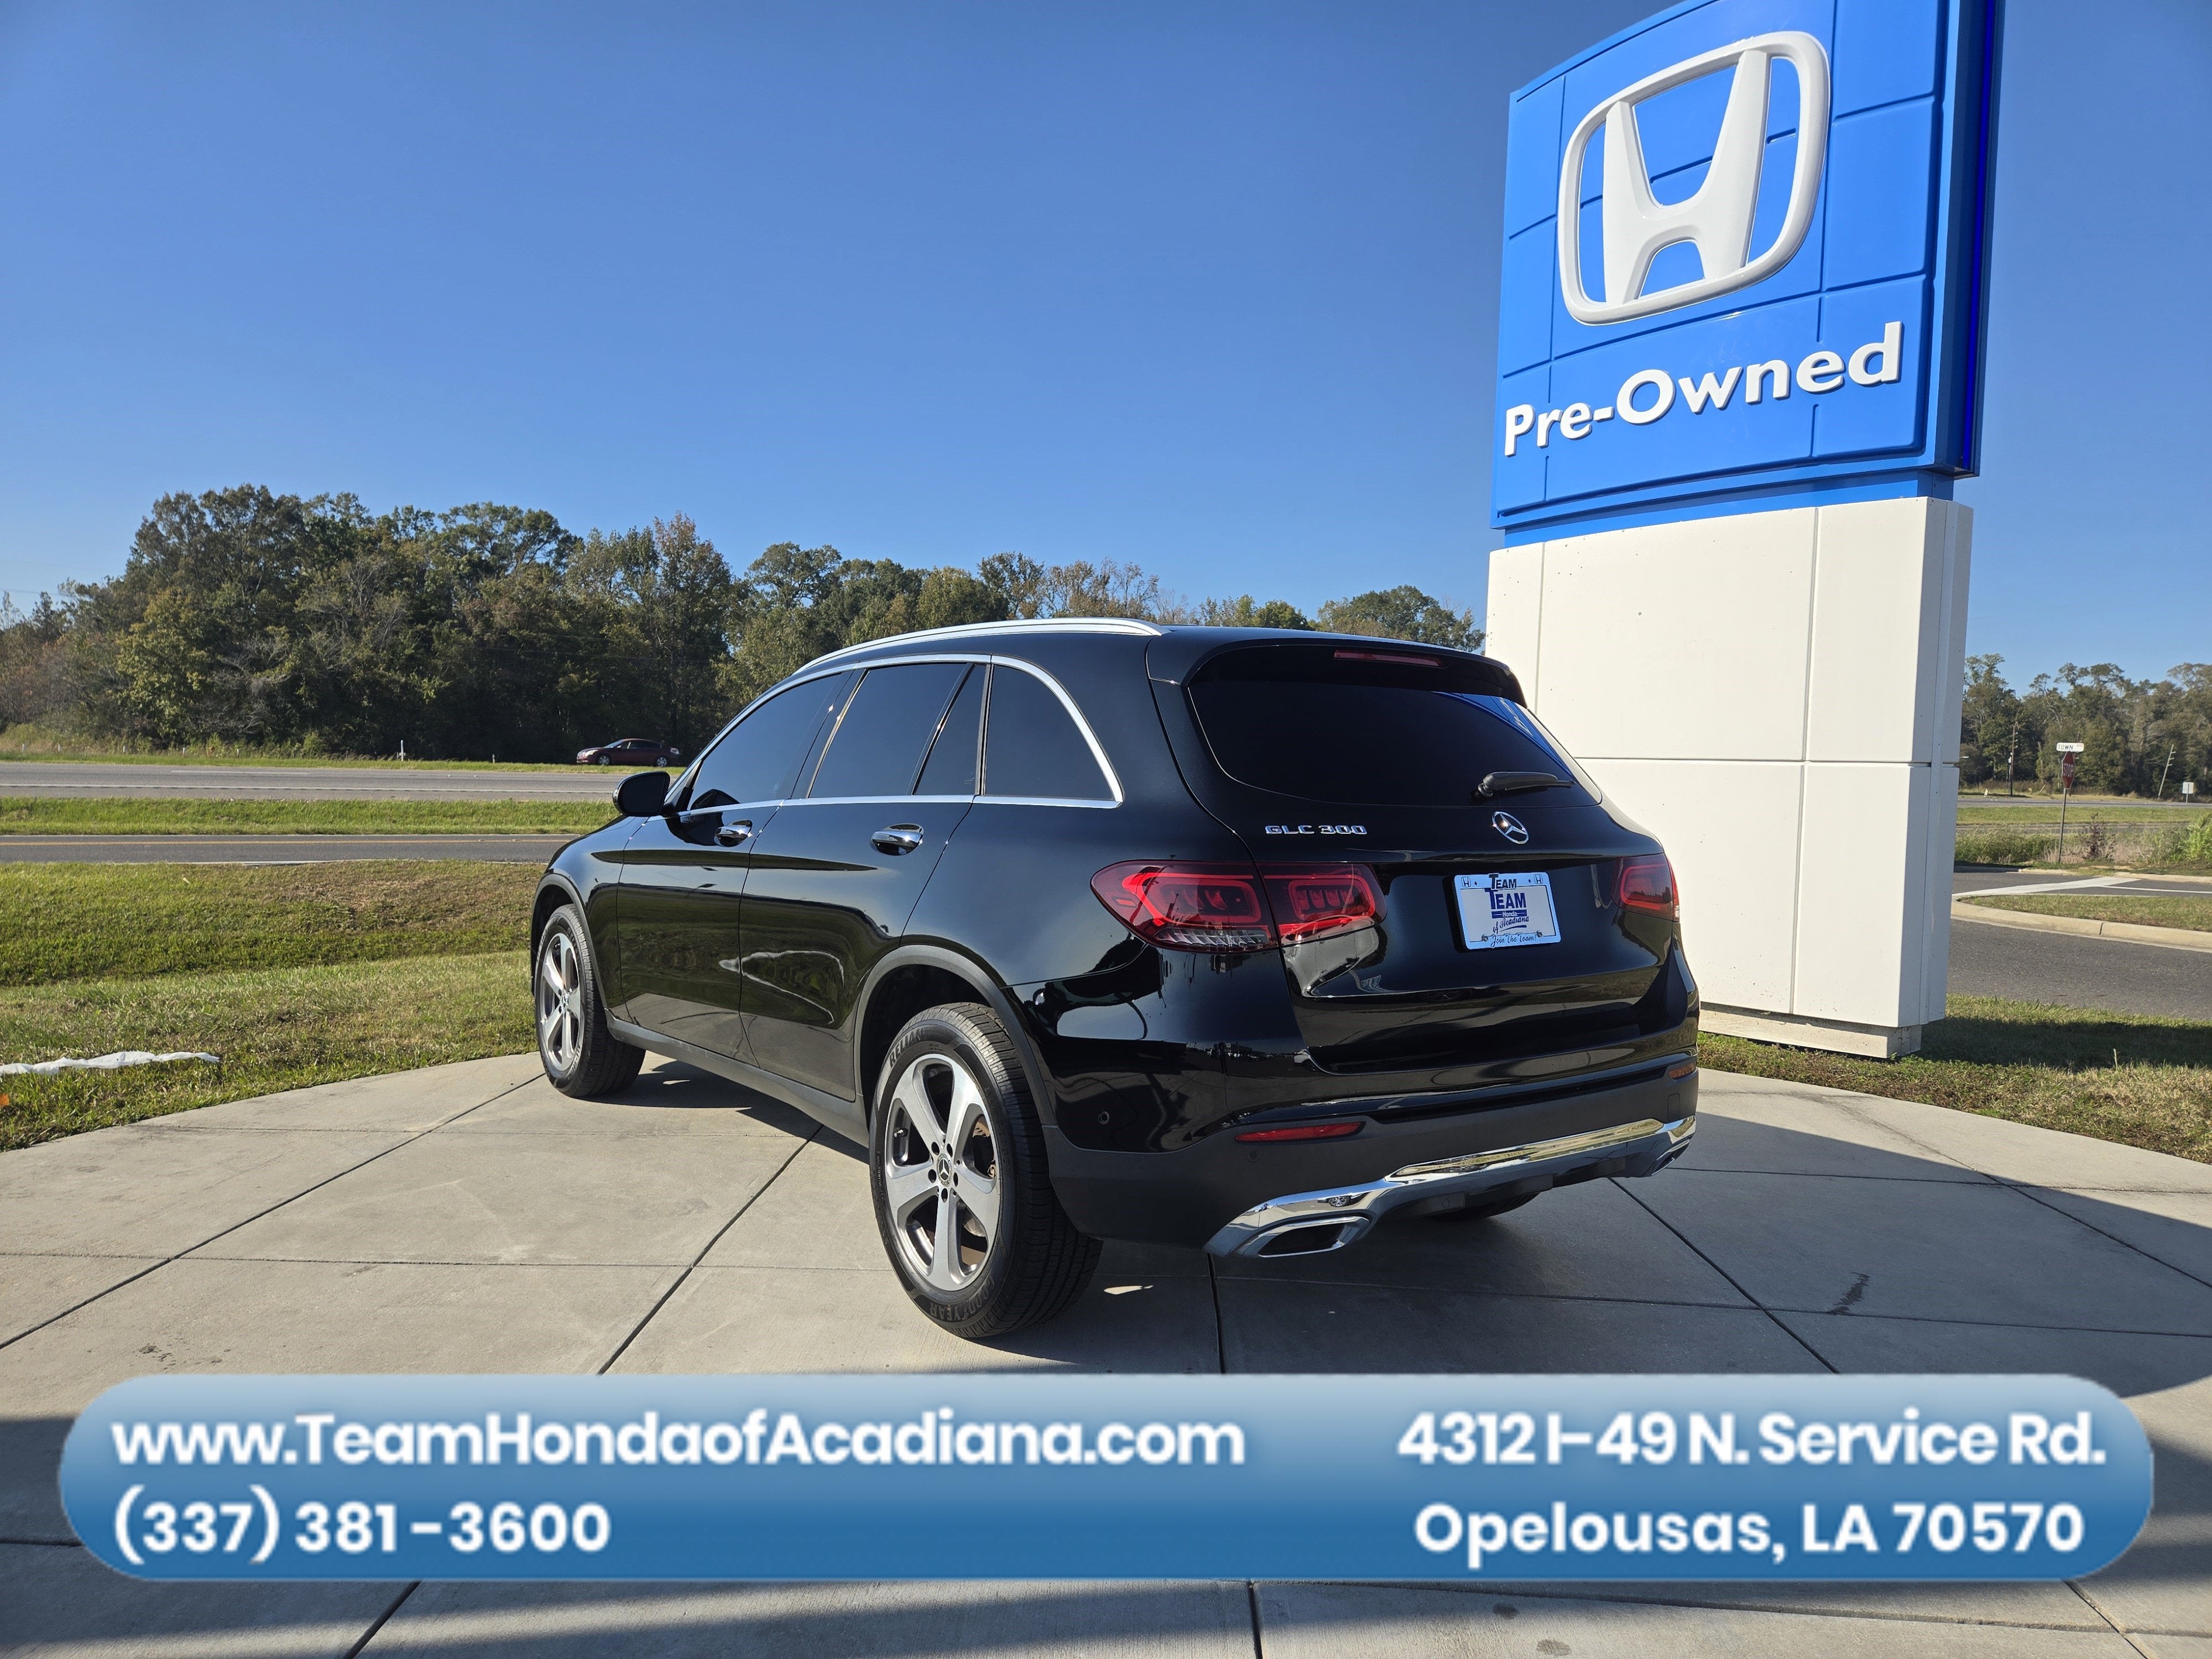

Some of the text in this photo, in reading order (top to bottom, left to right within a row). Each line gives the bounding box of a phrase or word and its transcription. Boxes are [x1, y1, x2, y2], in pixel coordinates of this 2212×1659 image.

[1504, 321, 1905, 457] Pre-Owned
[2063, 763, 2074, 778] STOP
[1265, 825, 1368, 834] GLC 300
[1488, 873, 1517, 889] TEAM
[1485, 888, 1527, 910] TEAM
[1493, 916, 1530, 933] of Acadiana
[1491, 935, 1505, 948] Join
[1507, 935, 1517, 943] The
[889, 1026, 931, 1068] RELIANT
